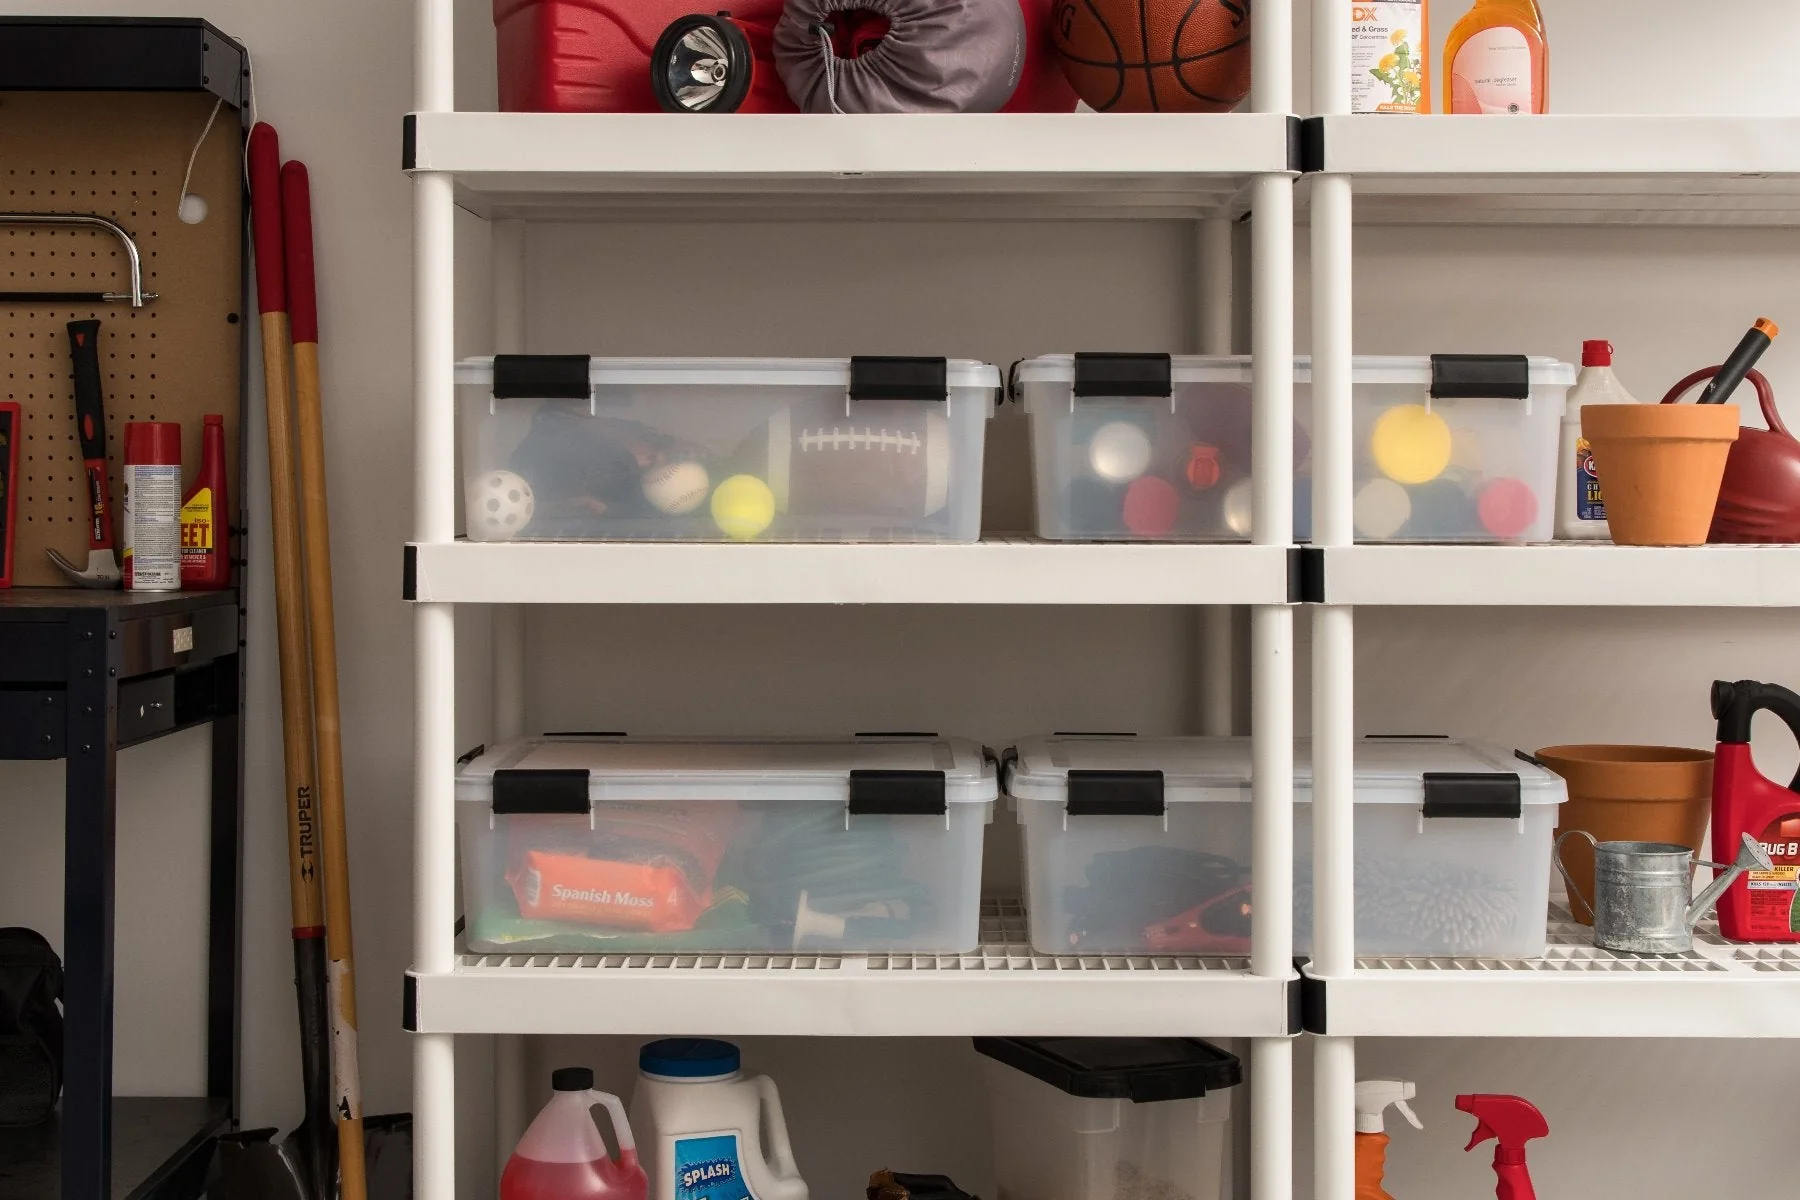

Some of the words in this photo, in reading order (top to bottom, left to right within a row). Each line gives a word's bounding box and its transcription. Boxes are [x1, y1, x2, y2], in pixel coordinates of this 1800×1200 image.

[298, 786, 313, 858] TRUPER
[552, 884, 610, 904] Spanish
[614, 891, 655, 908] Moss
[683, 1163, 730, 1187] SPLASH
